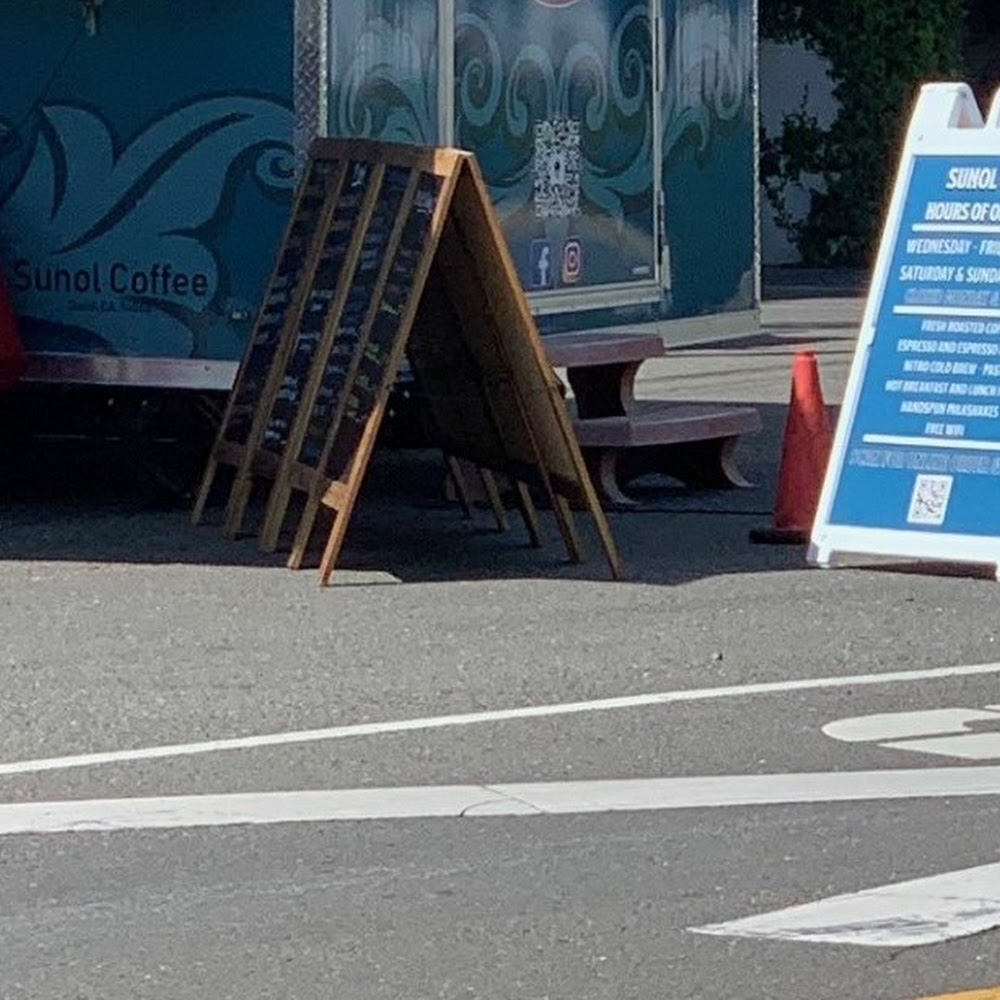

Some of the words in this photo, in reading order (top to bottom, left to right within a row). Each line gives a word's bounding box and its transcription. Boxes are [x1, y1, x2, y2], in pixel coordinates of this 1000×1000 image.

[945, 167, 998, 190] SUNOL
[925, 201, 969, 221] HOURS
[970, 202, 989, 222] OF
[906, 239, 972, 255] WEDNESDAY
[12, 259, 101, 293] Sunol
[109, 261, 208, 297] Coffee
[899, 265, 955, 281] SATURDAY
[954, 266, 964, 282] &
[897, 339, 937, 353] ESPRESSO
[937, 340, 956, 354] AND
